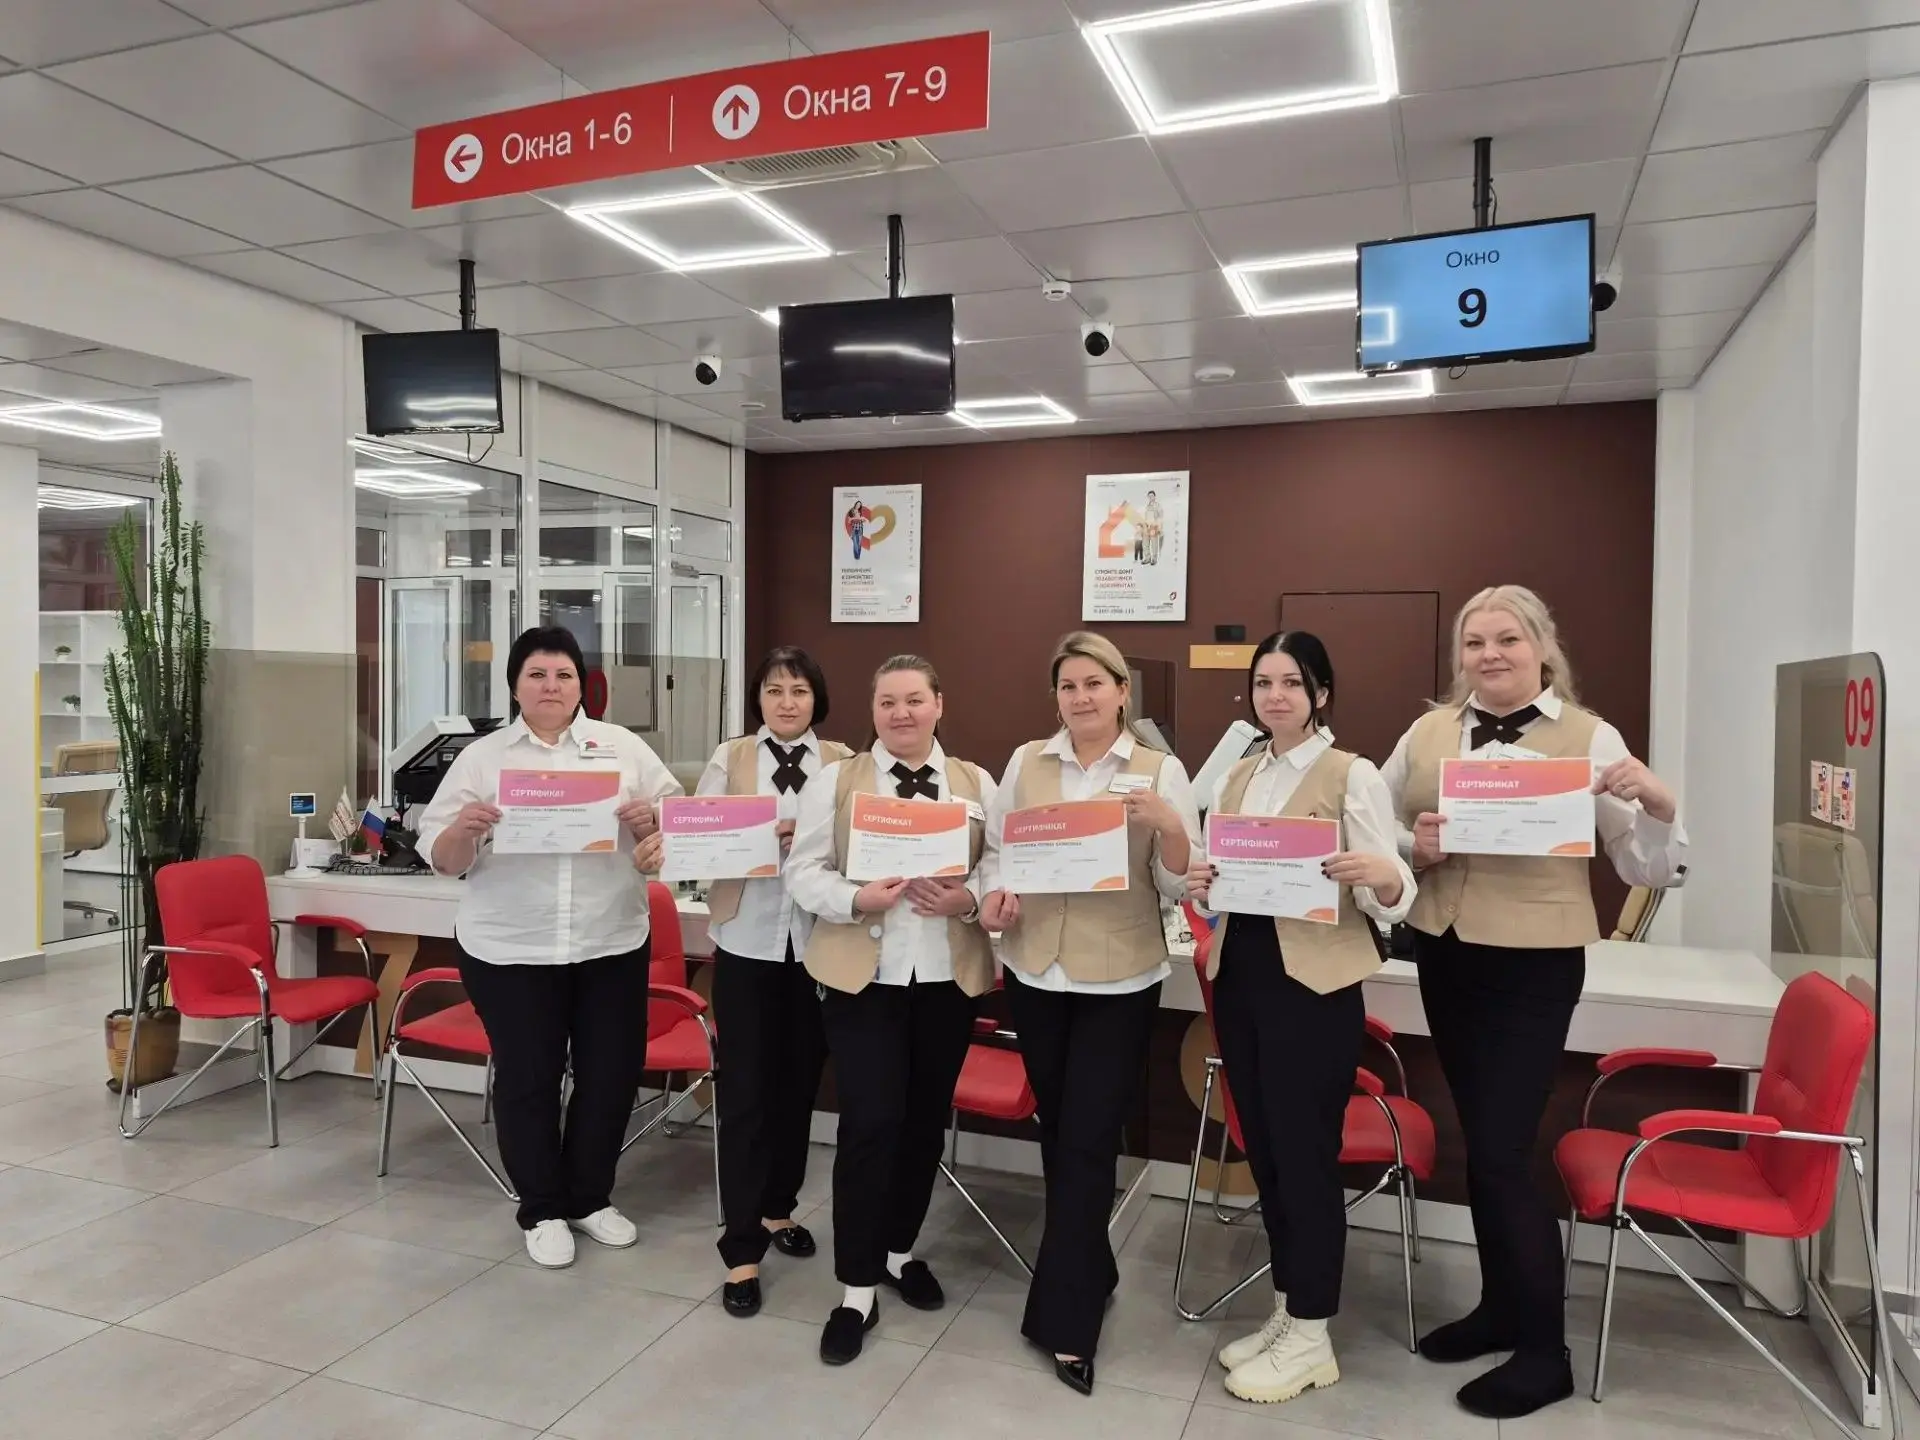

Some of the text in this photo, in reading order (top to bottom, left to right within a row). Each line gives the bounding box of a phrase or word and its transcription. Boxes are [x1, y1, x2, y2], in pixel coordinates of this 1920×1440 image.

[784, 65, 949, 120] Окна 7-9
[501, 112, 633, 165] Окна 1-6
[1446, 249, 1500, 268] Окно
[1458, 288, 1487, 328] 9
[1845, 677, 1875, 747] 09
[1455, 780, 1520, 789] СЕРТИФИКАТ
[510, 788, 567, 798] СЕРТИФИКАТ
[672, 815, 724, 824] СЕРТИФИКАТ
[863, 813, 913, 827] СЕРТИФИКАТ
[1013, 821, 1068, 835] СЕРТИФИКАТ
[1220, 837, 1281, 849] СЕРТИФИКАТ
